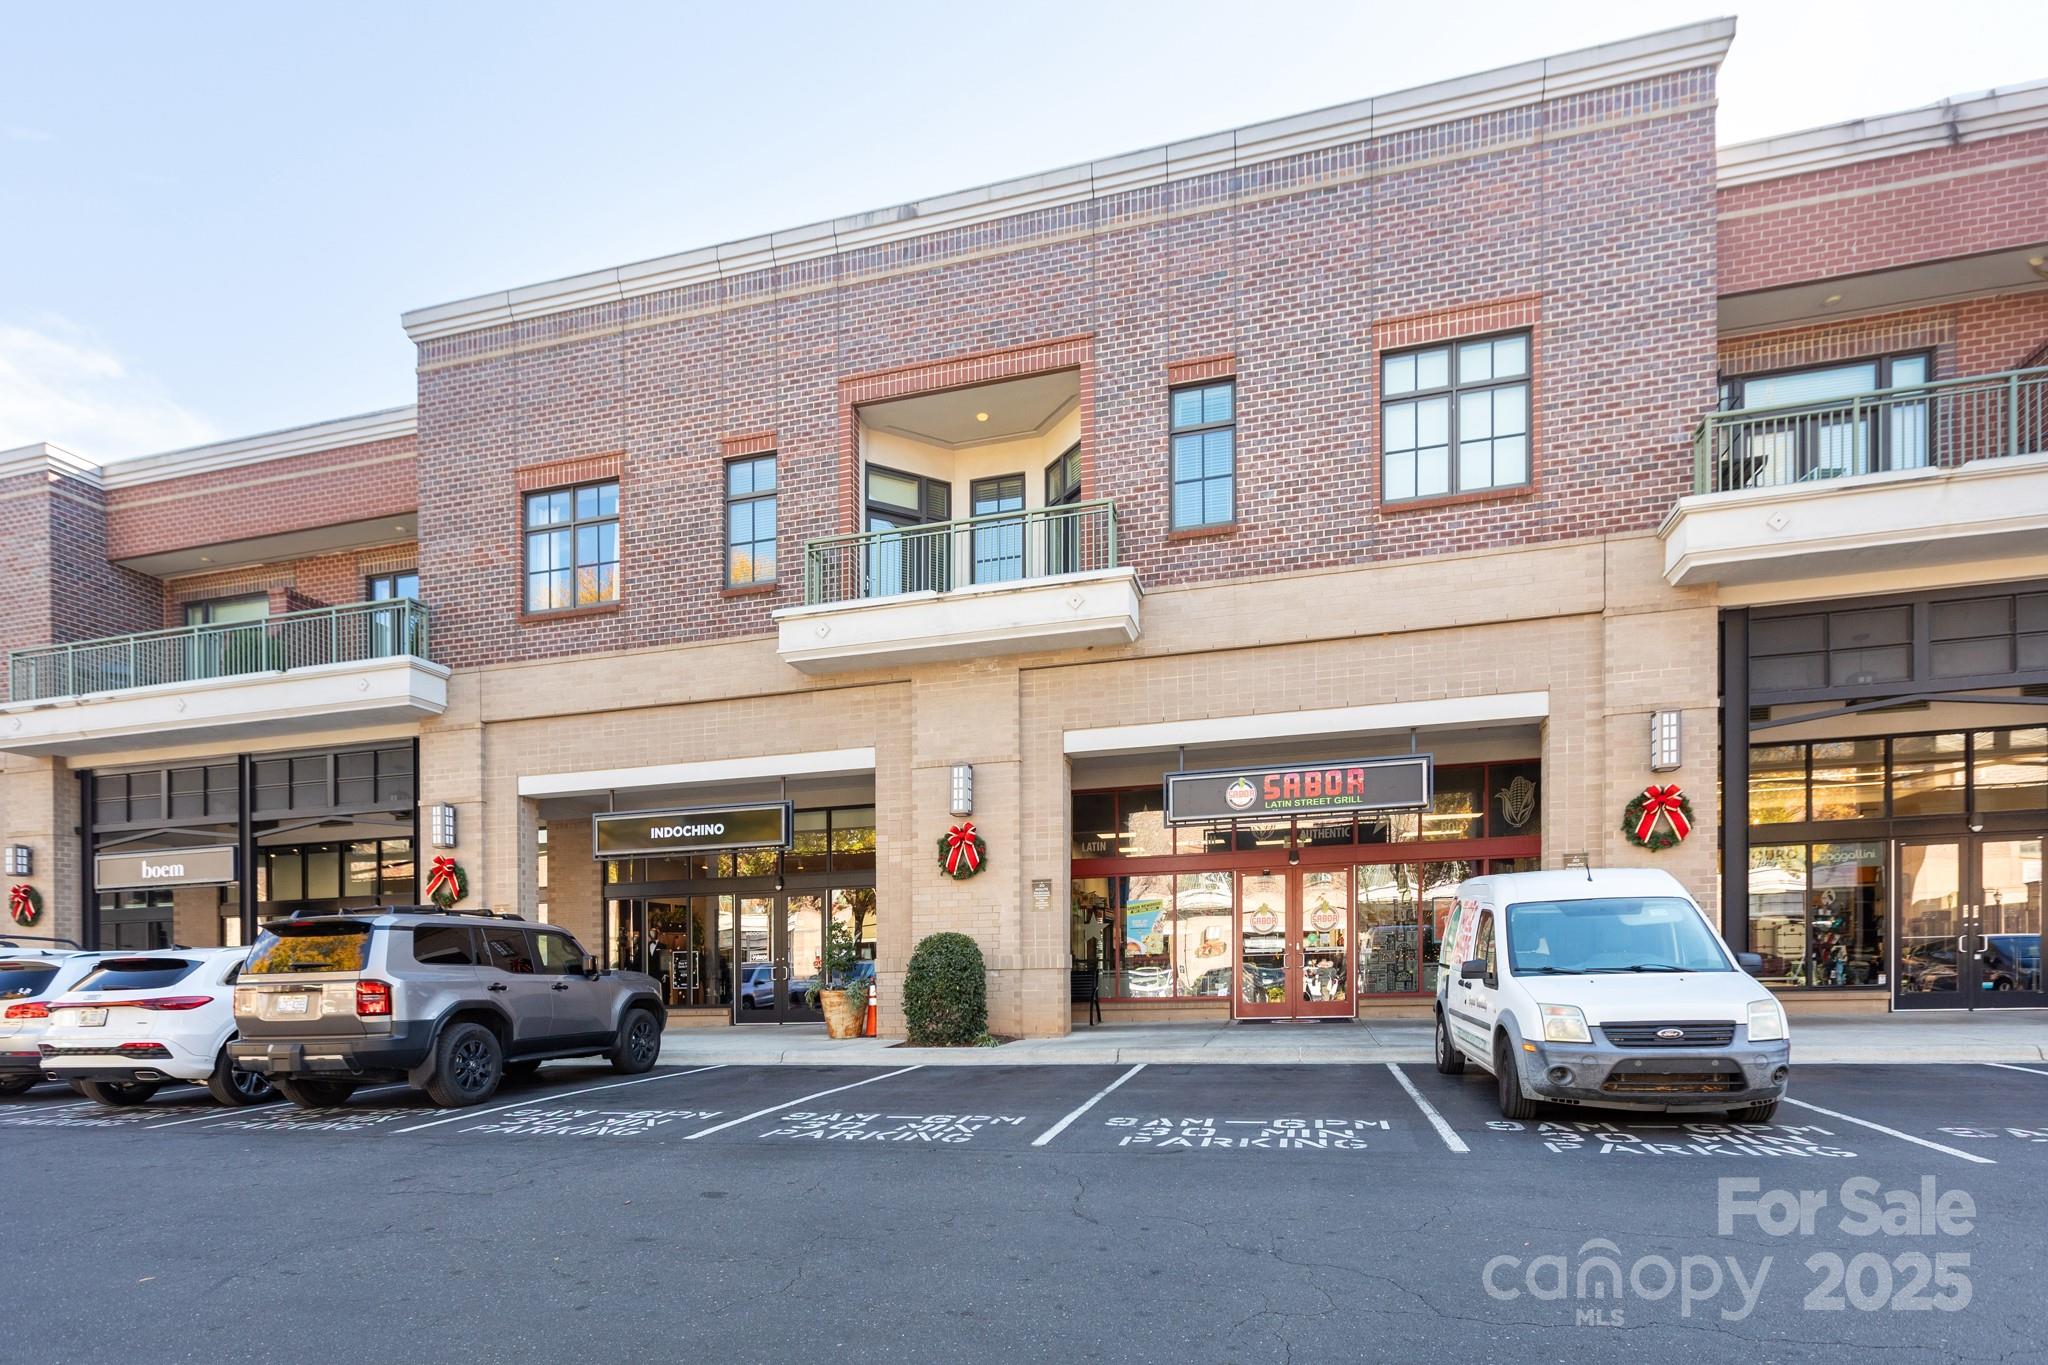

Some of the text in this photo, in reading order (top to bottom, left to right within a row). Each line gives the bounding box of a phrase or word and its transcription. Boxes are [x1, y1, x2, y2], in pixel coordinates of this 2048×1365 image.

[1264, 768, 1365, 800] SABOR
[1265, 796, 1363, 809] LATIN STREET GRILL
[650, 823, 725, 839] INDOCHINO
[1300, 826, 1351, 840] AUTHENTIC
[1081, 841, 1107, 852] LATIN
[141, 860, 184, 878] boem
[1251, 916, 1277, 925] SABOR
[1312, 914, 1338, 923] SABOR
[457, 1124, 649, 1136] PARKING
[792, 1121, 983, 1133] 30 MIN
[1136, 1127, 1362, 1139] 30 MIN
[758, 1129, 975, 1143] PARKING
[1118, 1136, 1369, 1150] PARKING
[1540, 1132, 1820, 1146] 30 MIN
[1543, 1142, 1858, 1159] PARKING
